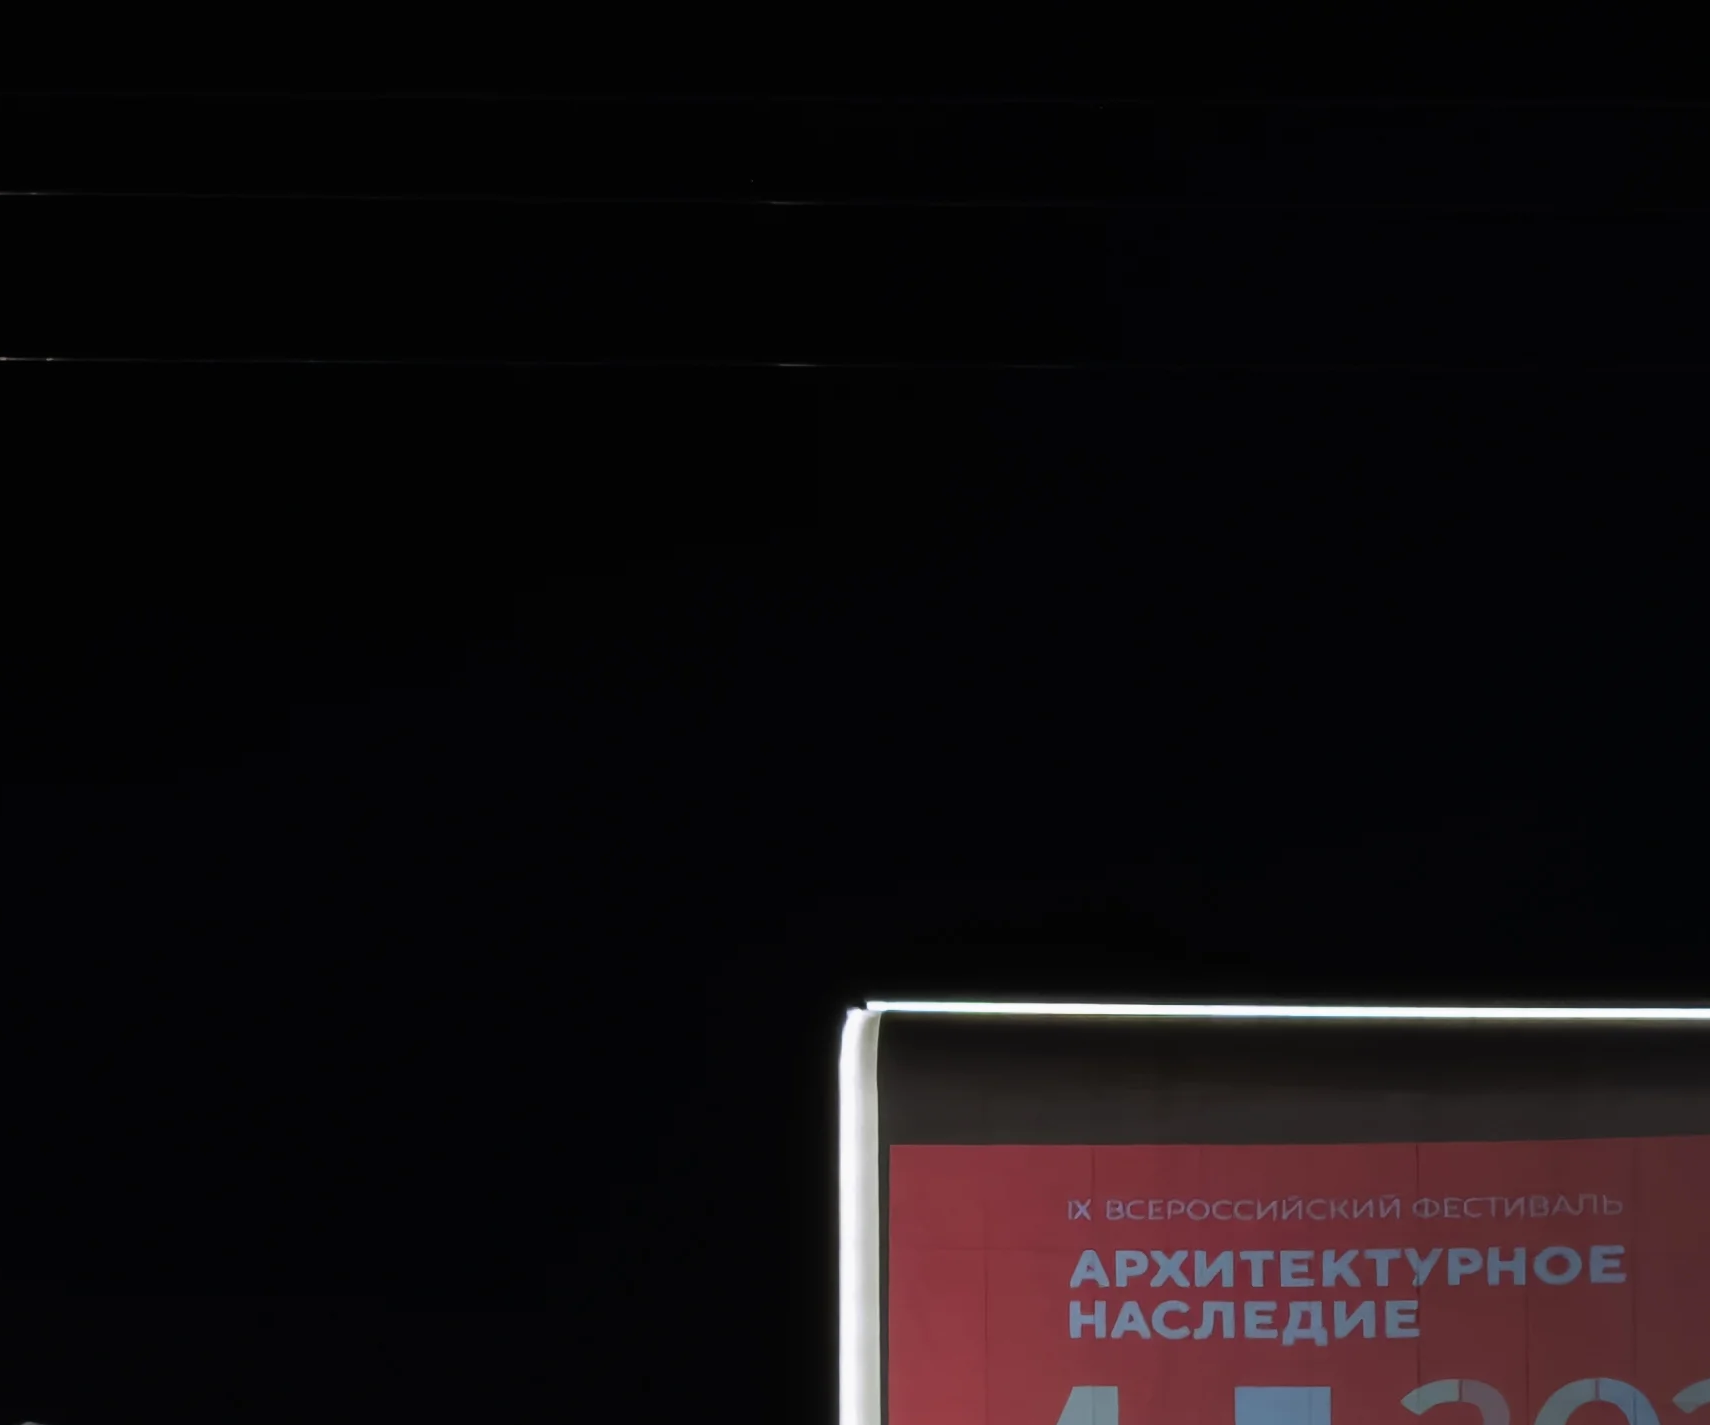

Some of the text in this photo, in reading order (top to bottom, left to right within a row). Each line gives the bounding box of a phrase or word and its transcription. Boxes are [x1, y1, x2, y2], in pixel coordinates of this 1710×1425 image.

[1105, 1195, 1401, 1222] ВСЕРОССИЙСКИЙ
[1412, 1193, 1624, 1219] ФЕСТИВАЛЬ
[1069, 1244, 1628, 1289] АРХИТЕКТУРНОЕ
[1068, 1298, 1421, 1347] НАСЛЕДИЕ
